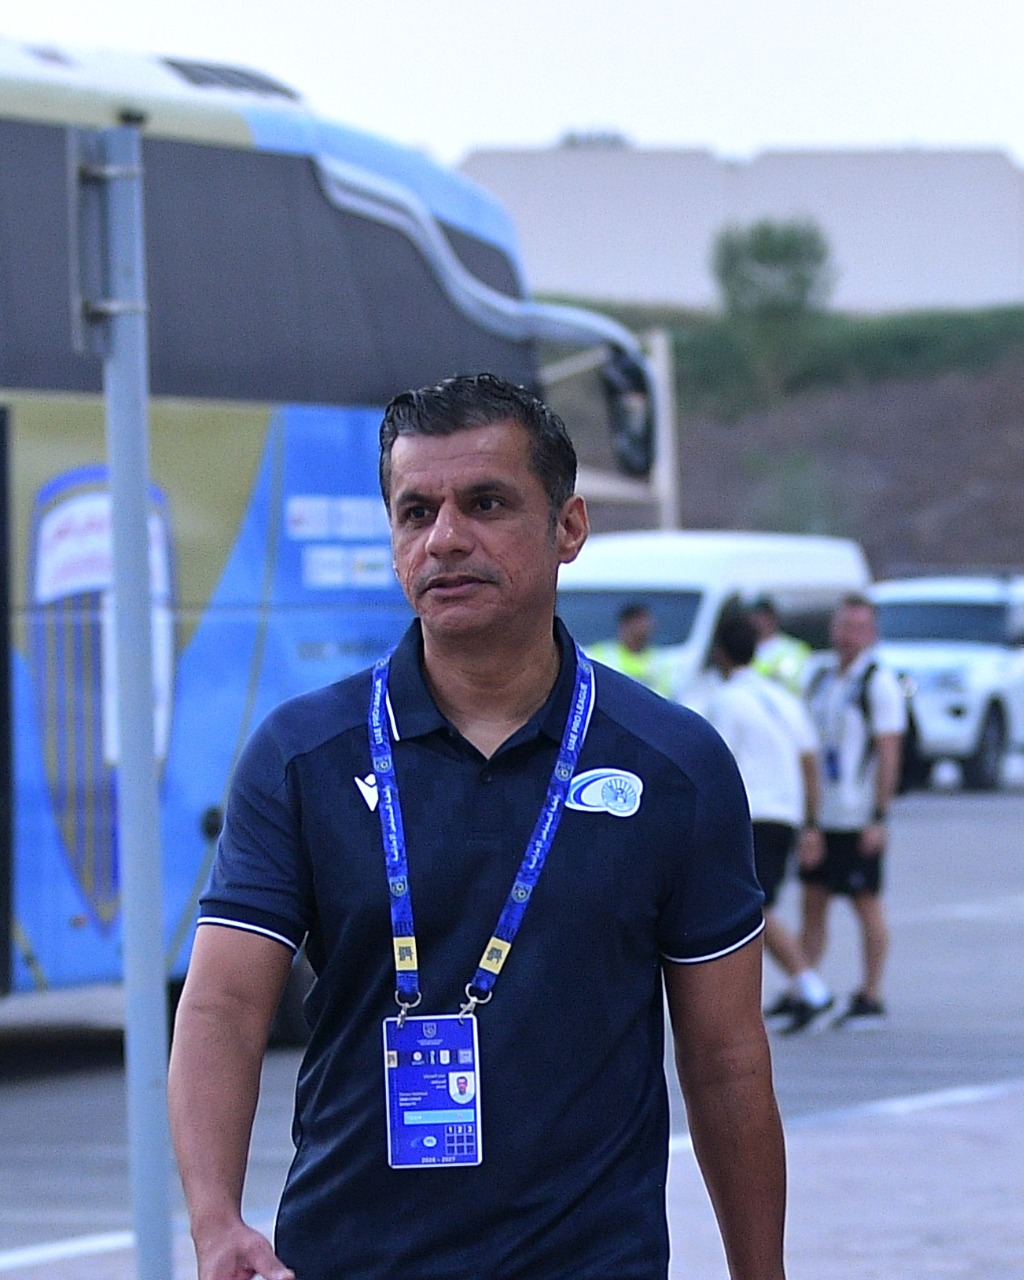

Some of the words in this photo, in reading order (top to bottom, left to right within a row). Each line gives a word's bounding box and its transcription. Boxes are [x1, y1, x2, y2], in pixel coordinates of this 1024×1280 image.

[574, 681, 587, 714] LEAGUE
[570, 714, 581, 733] PRO
[373, 727, 383, 744] UAE
[566, 732, 578, 750] UAE
